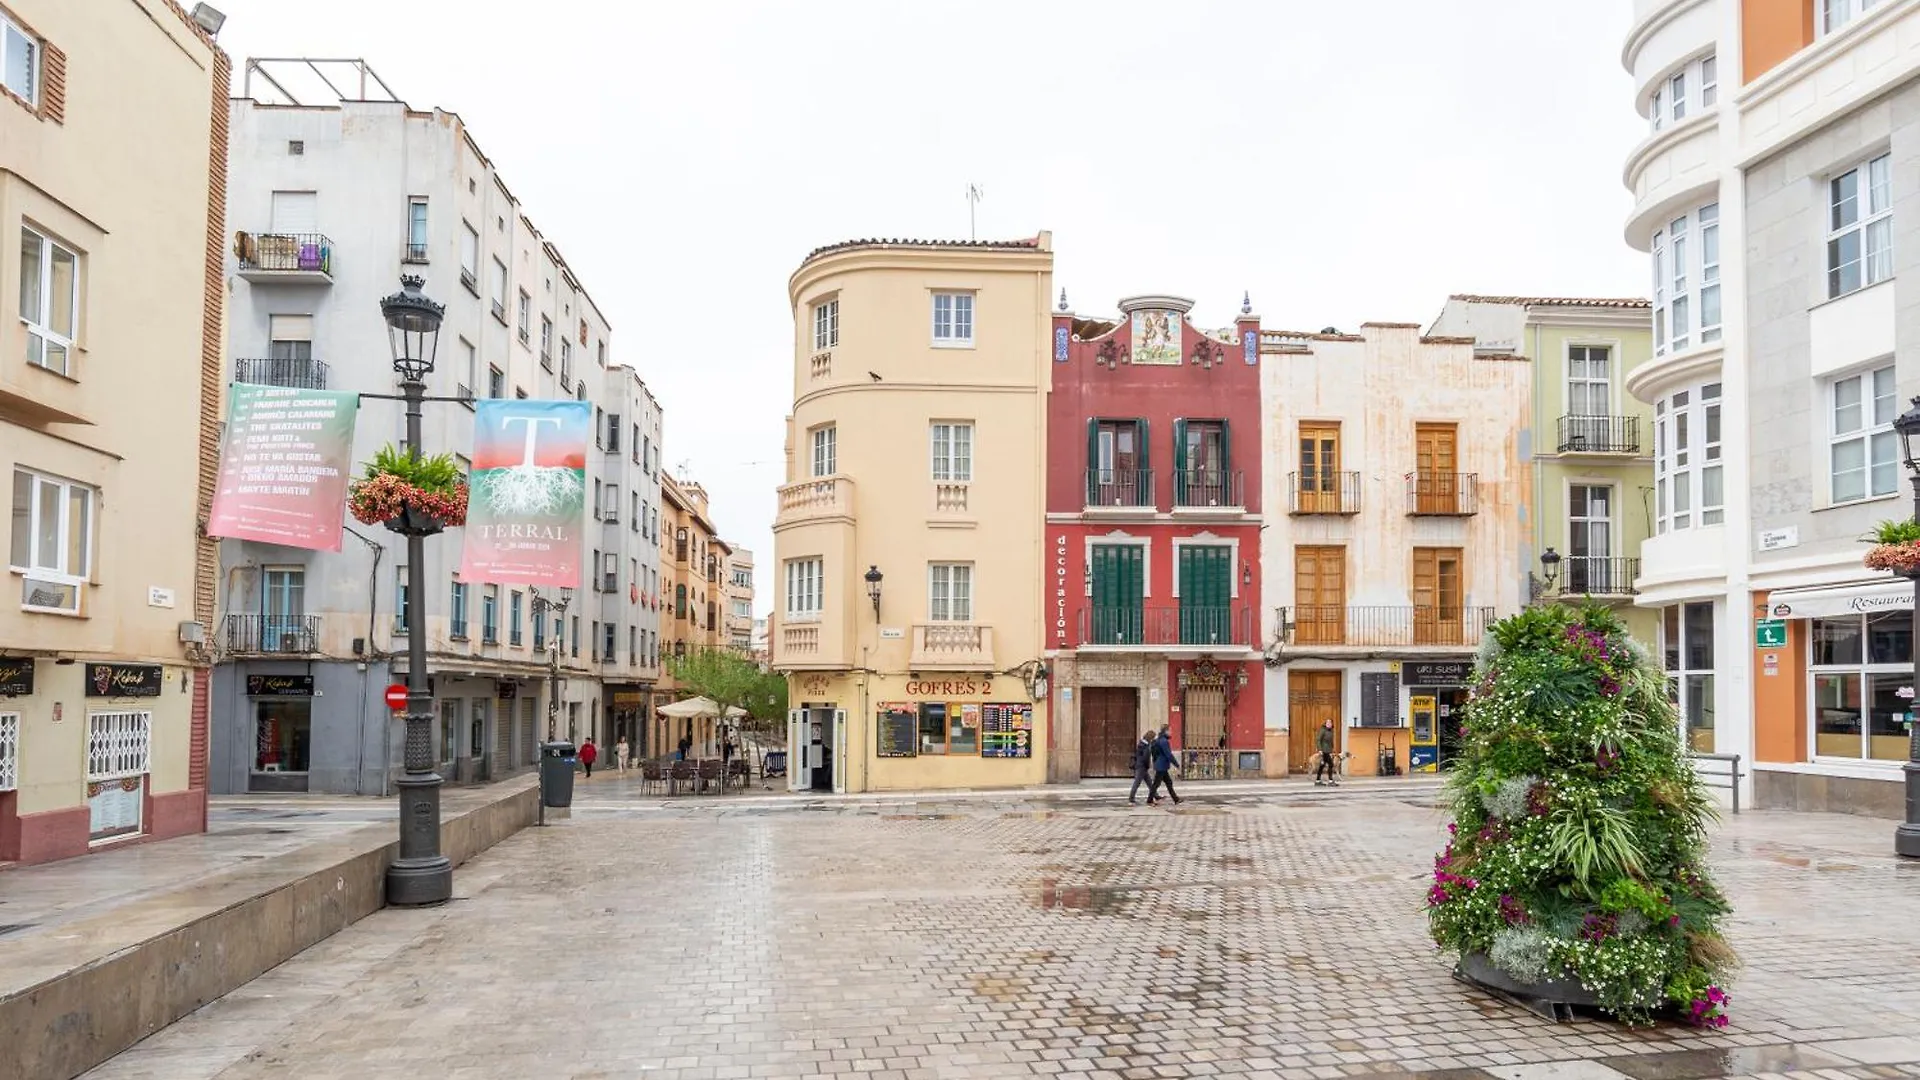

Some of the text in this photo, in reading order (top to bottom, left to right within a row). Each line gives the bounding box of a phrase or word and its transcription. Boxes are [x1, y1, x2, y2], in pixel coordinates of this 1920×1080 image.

[480, 523, 568, 541] TERRAL
[1057, 535, 1066, 638] decoración
[982, 681, 992, 695] 2
